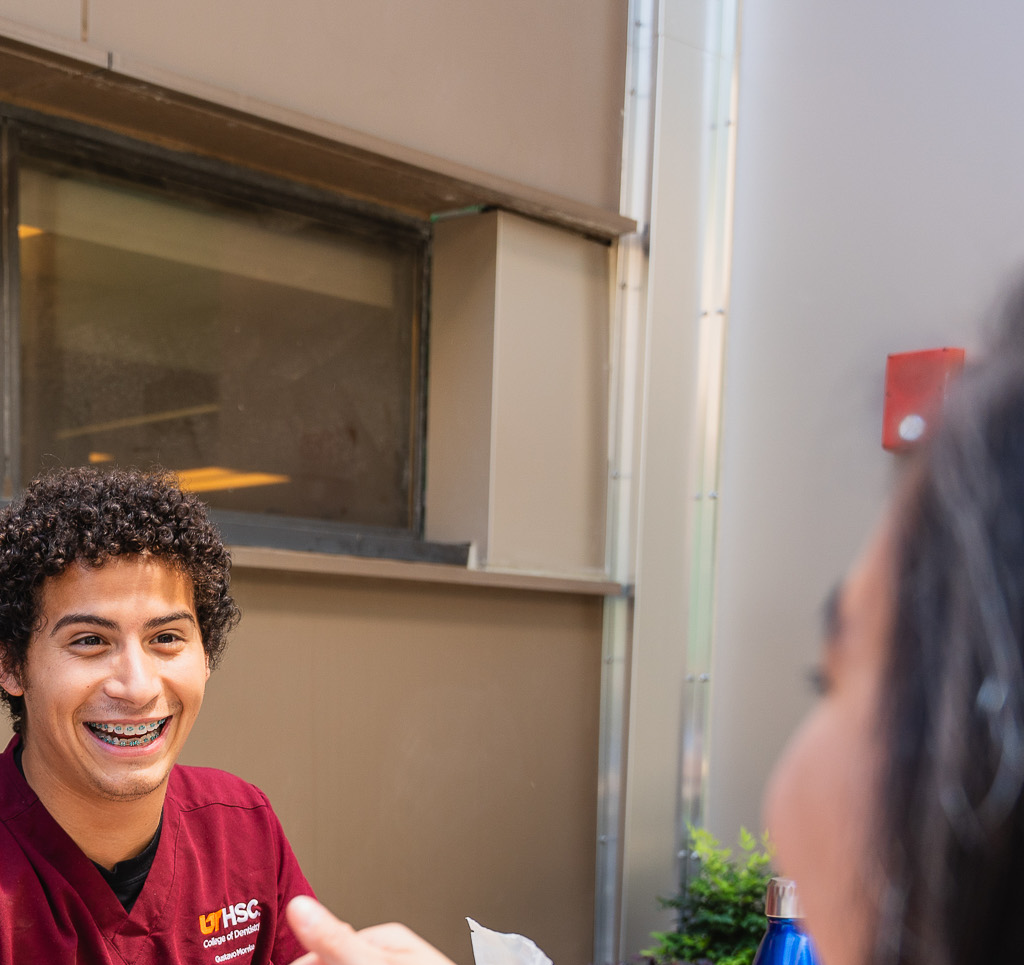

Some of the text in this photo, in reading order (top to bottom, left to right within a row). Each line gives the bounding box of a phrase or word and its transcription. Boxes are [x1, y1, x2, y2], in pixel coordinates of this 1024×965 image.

[199, 899, 259, 935] UTHSC
[203, 935, 226, 948] College
[226, 931, 234, 941] of
